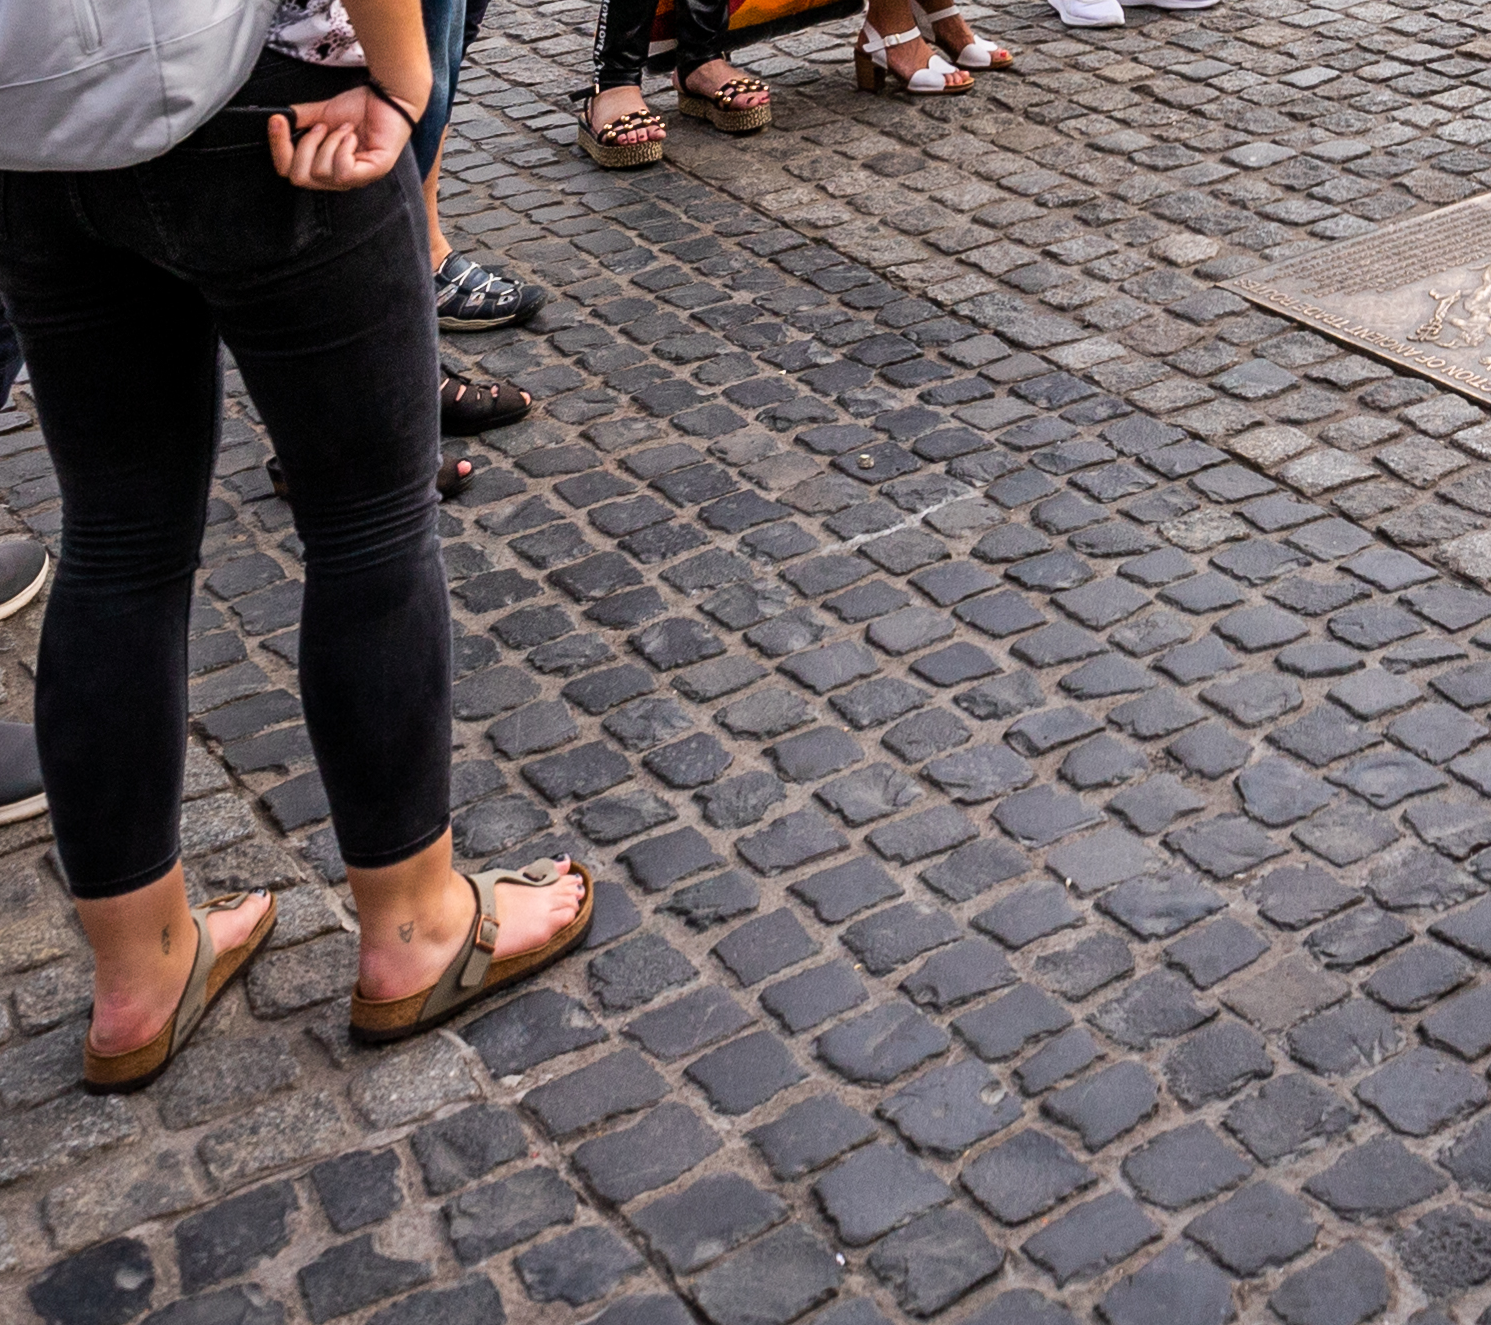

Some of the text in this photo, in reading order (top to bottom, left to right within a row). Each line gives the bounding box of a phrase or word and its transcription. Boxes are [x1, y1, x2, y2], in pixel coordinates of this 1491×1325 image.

[1231, 277, 1301, 313] ROUTES
[1293, 300, 1348, 333] TRADE
[1344, 323, 1425, 360] ANCIENT
[1417, 350, 1447, 372] OF
